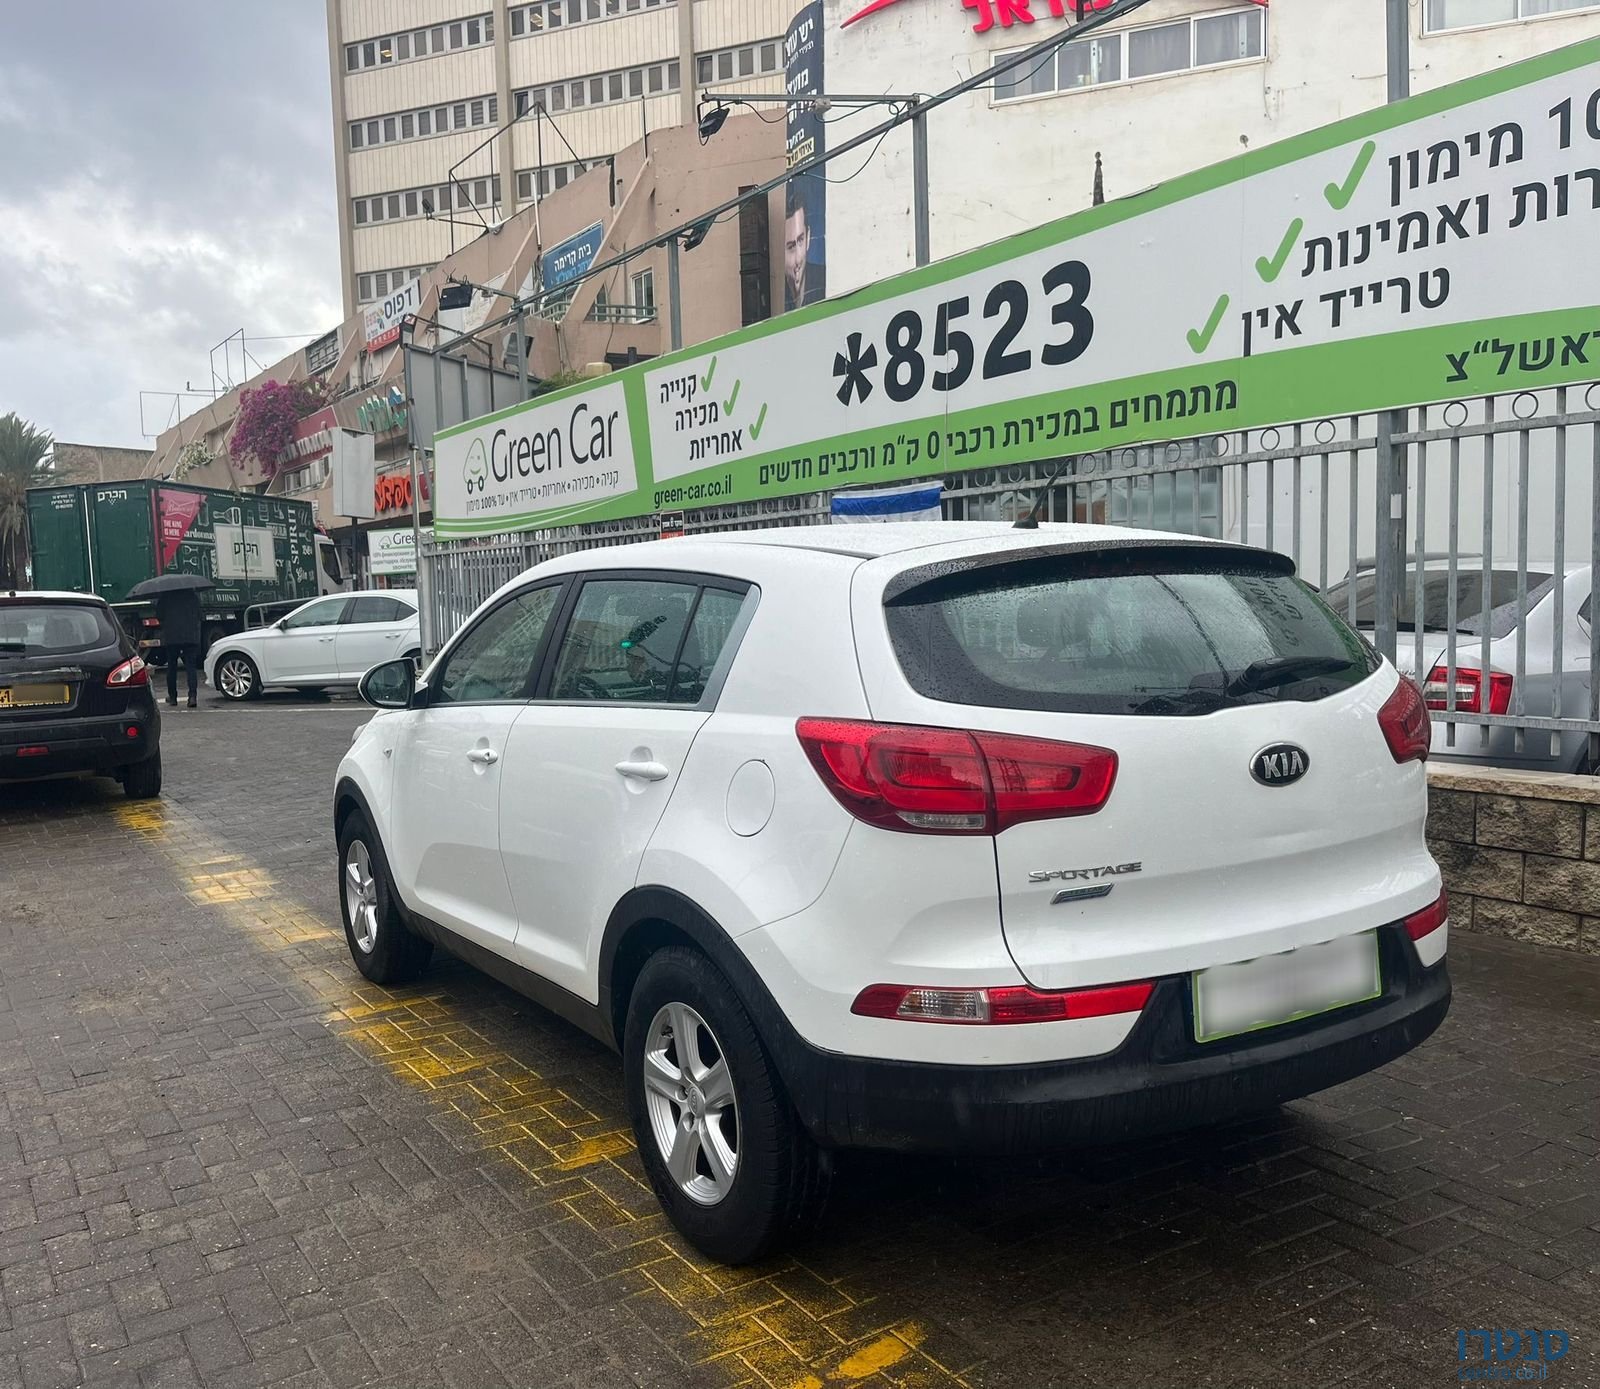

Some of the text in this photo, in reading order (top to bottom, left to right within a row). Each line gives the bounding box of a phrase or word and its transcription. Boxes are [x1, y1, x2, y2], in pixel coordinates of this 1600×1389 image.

[1388, 122, 1523, 207] מימון
[1301, 193, 1489, 278] ואמינות
[554, 250, 576, 273] קדימה
[578, 243, 592, 260] בית
[384, 287, 412, 319] דפוס
[1241, 267, 1451, 357] טרייד אין
[1446, 330, 1600, 383] אשל"צ
[660, 374, 697, 403] קנייה
[675, 401, 718, 431] מכירה
[1110, 380, 1238, 429] מתמחים
[947, 425, 995, 456] רכבי
[1002, 406, 1100, 448] במכירת
[491, 403, 618, 483] Green Car
[690, 429, 742, 460] אחריות
[927, 430, 940, 460] 0
[759, 457, 813, 486] חדשים
[818, 446, 876, 476] ורכבים
[519, 487, 537, 501] טרייד
[542, 481, 566, 497] אחריות
[571, 475, 595, 492] מכירה
[601, 470, 619, 488] קניה
[654, 474, 732, 509] green-car.co.il
[97, 490, 127, 503] הכרם
[466, 499, 480, 516] מימון
[481, 497, 497, 509] 100%
[509, 493, 518, 507] אין
[287, 506, 300, 564] SPIRIT
[216, 593, 240, 602] WHISKY
[1261, 750, 1304, 780] KIA
[1028, 862, 1142, 883] SPORTAGE
